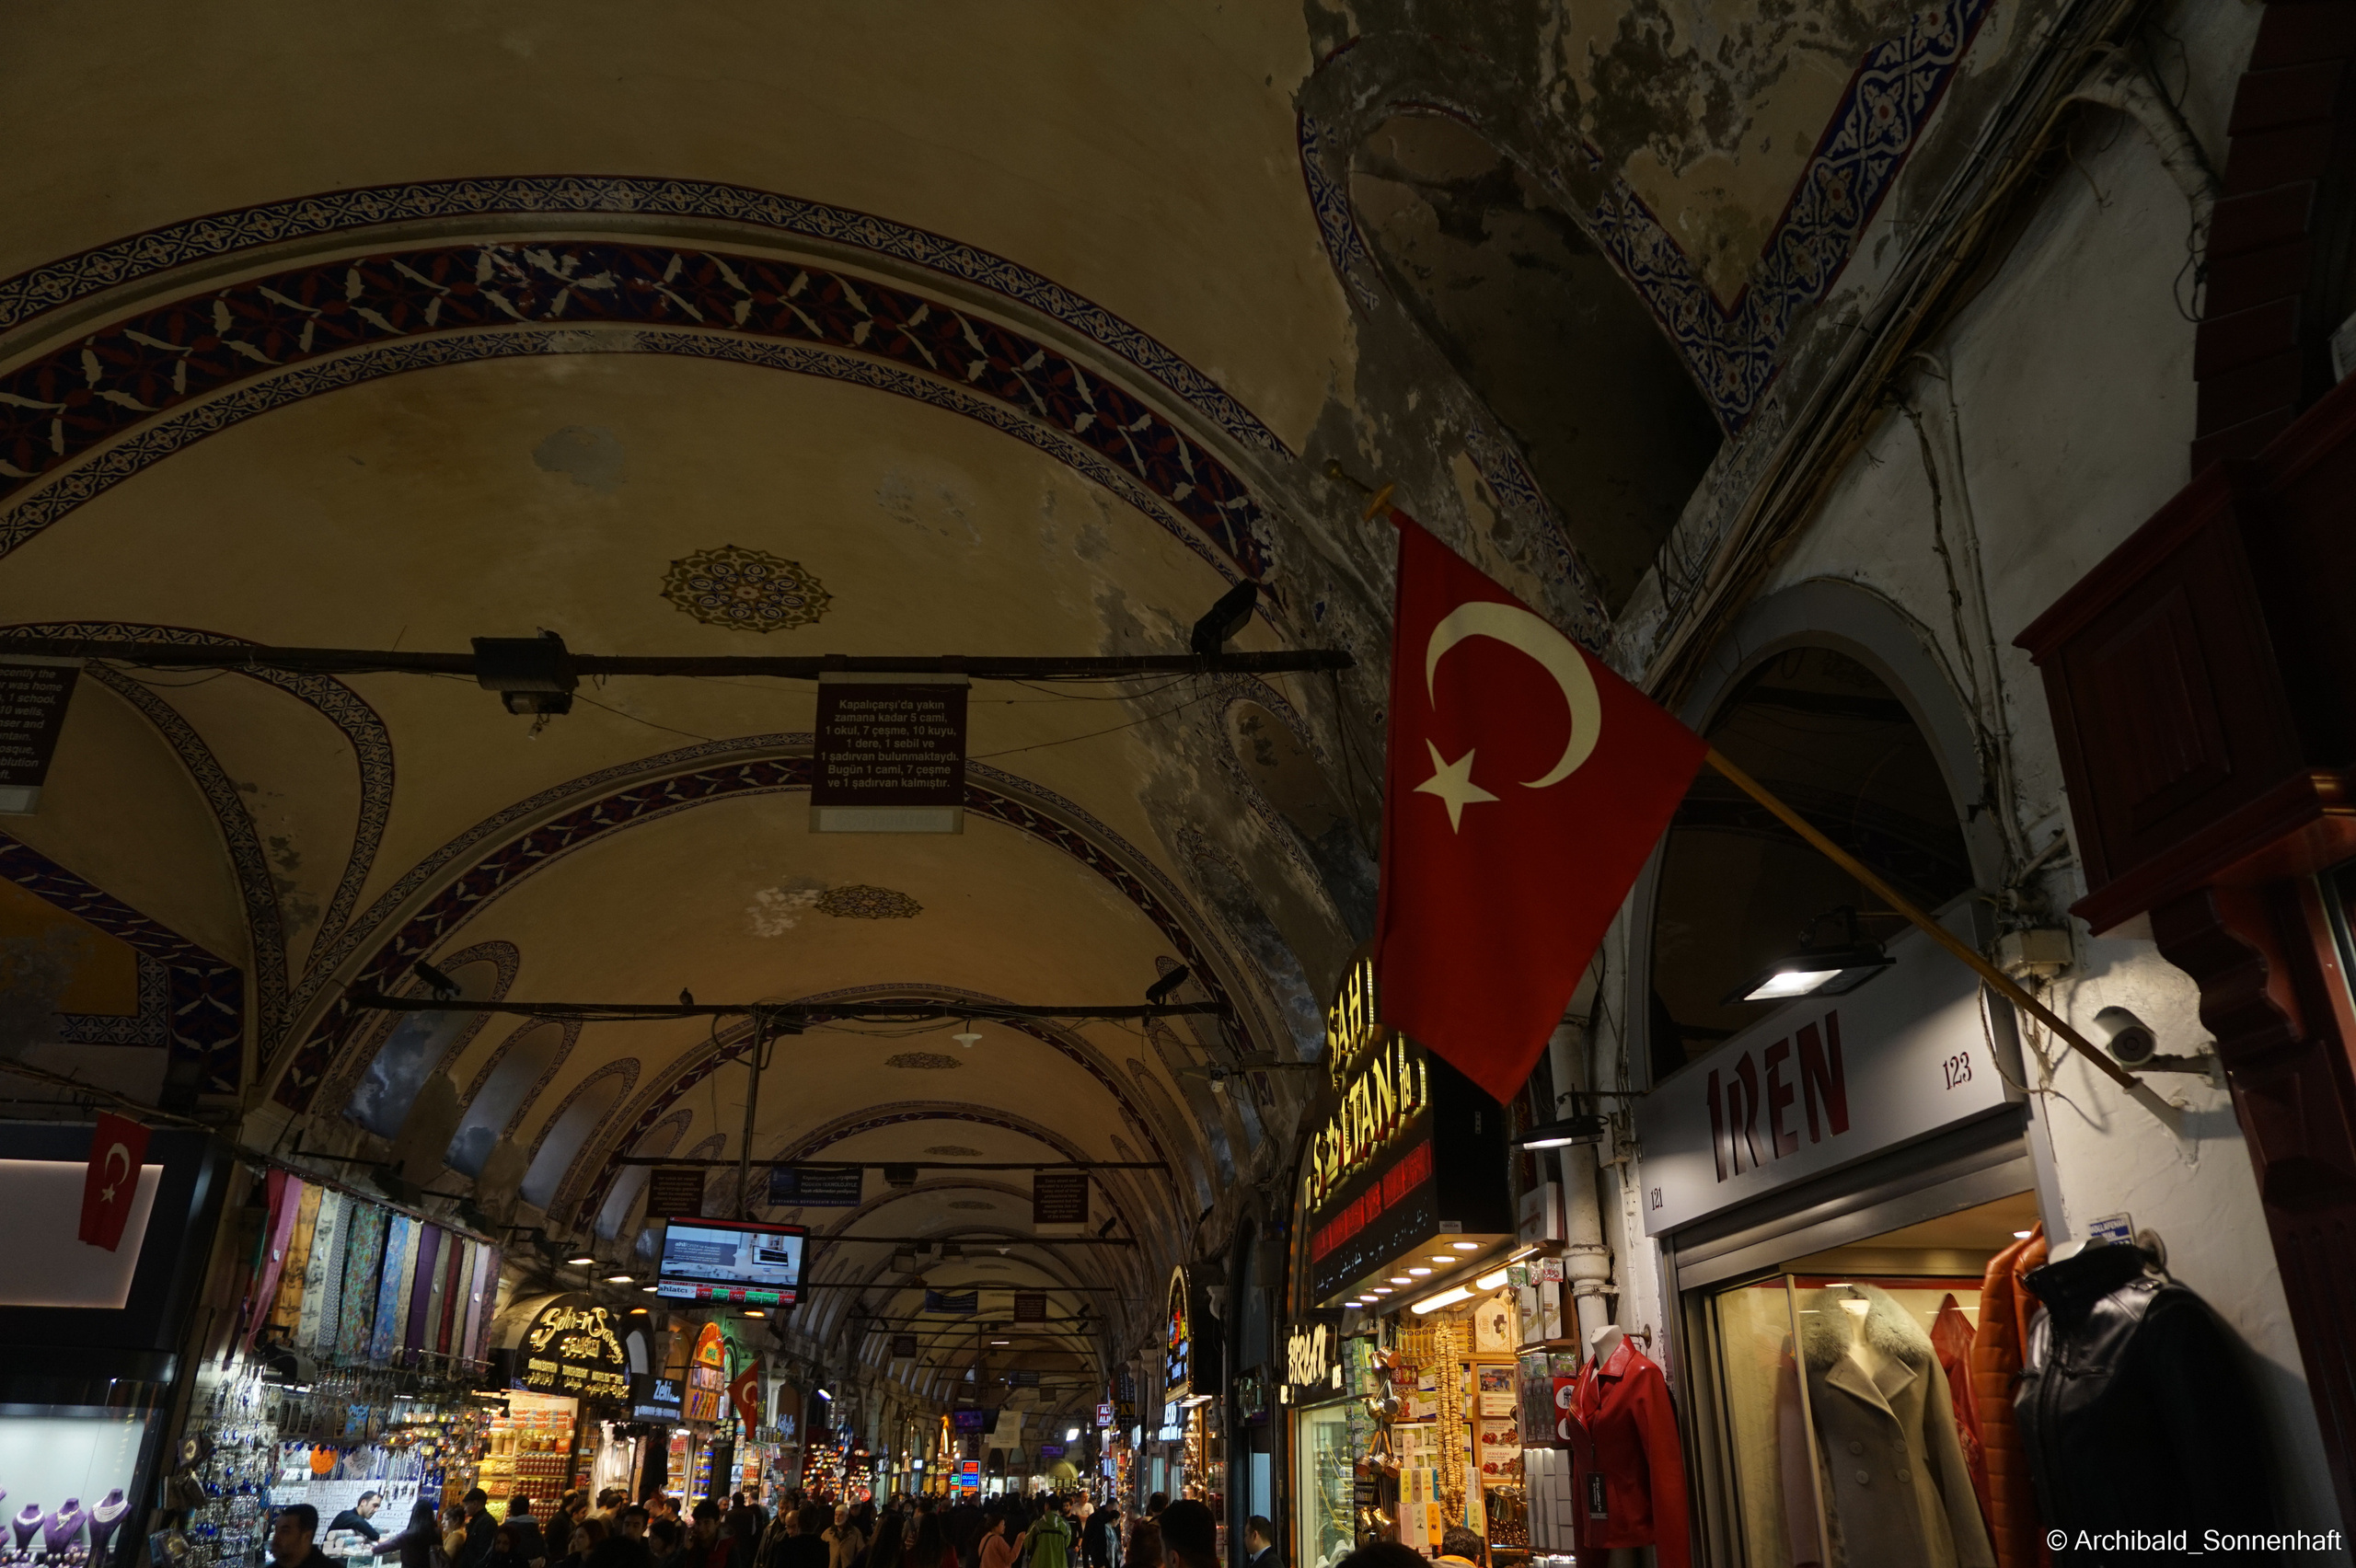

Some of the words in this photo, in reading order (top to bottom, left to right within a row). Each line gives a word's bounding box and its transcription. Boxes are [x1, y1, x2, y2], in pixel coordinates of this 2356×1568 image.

[39, 670, 55, 678] the
[8, 682, 29, 690] was
[32, 682, 63, 691] home
[17, 695, 56, 704] school,
[839, 699, 913, 710] Kapalıçarşı'da
[917, 700, 944, 710] yakın
[15, 708, 44, 717] wells,
[878, 713, 907, 721] kadar
[919, 714, 947, 723] cami,
[826, 726, 830, 734] 1
[835, 726, 860, 735] okul,
[863, 726, 869, 734] 7
[872, 728, 909, 737] çeşme,
[914, 726, 925, 734] 10
[929, 726, 956, 736] kuyu,
[847, 739, 851, 747] 1
[855, 739, 882, 749] dere,
[885, 739, 890, 747] 1
[895, 739, 918, 747] sebil
[821, 752, 826, 760] 1
[829, 752, 874, 762] şadırvan
[878, 752, 959, 763] bulunmaktaydı.
[828, 765, 862, 776] Bugün
[867, 766, 871, 774] 1
[875, 765, 903, 775] cami,
[907, 766, 913, 774] 7
[917, 767, 951, 776] çeşme
[844, 778, 849, 787] 1
[852, 778, 897, 789] şadırvan
[901, 778, 950, 789] kalmıştır.
[1943, 1051, 1972, 1090] 123
[1399, 1063, 1412, 1112] 119
[1651, 1187, 1662, 1211] 121
[653, 1379, 673, 1401] Zeki
